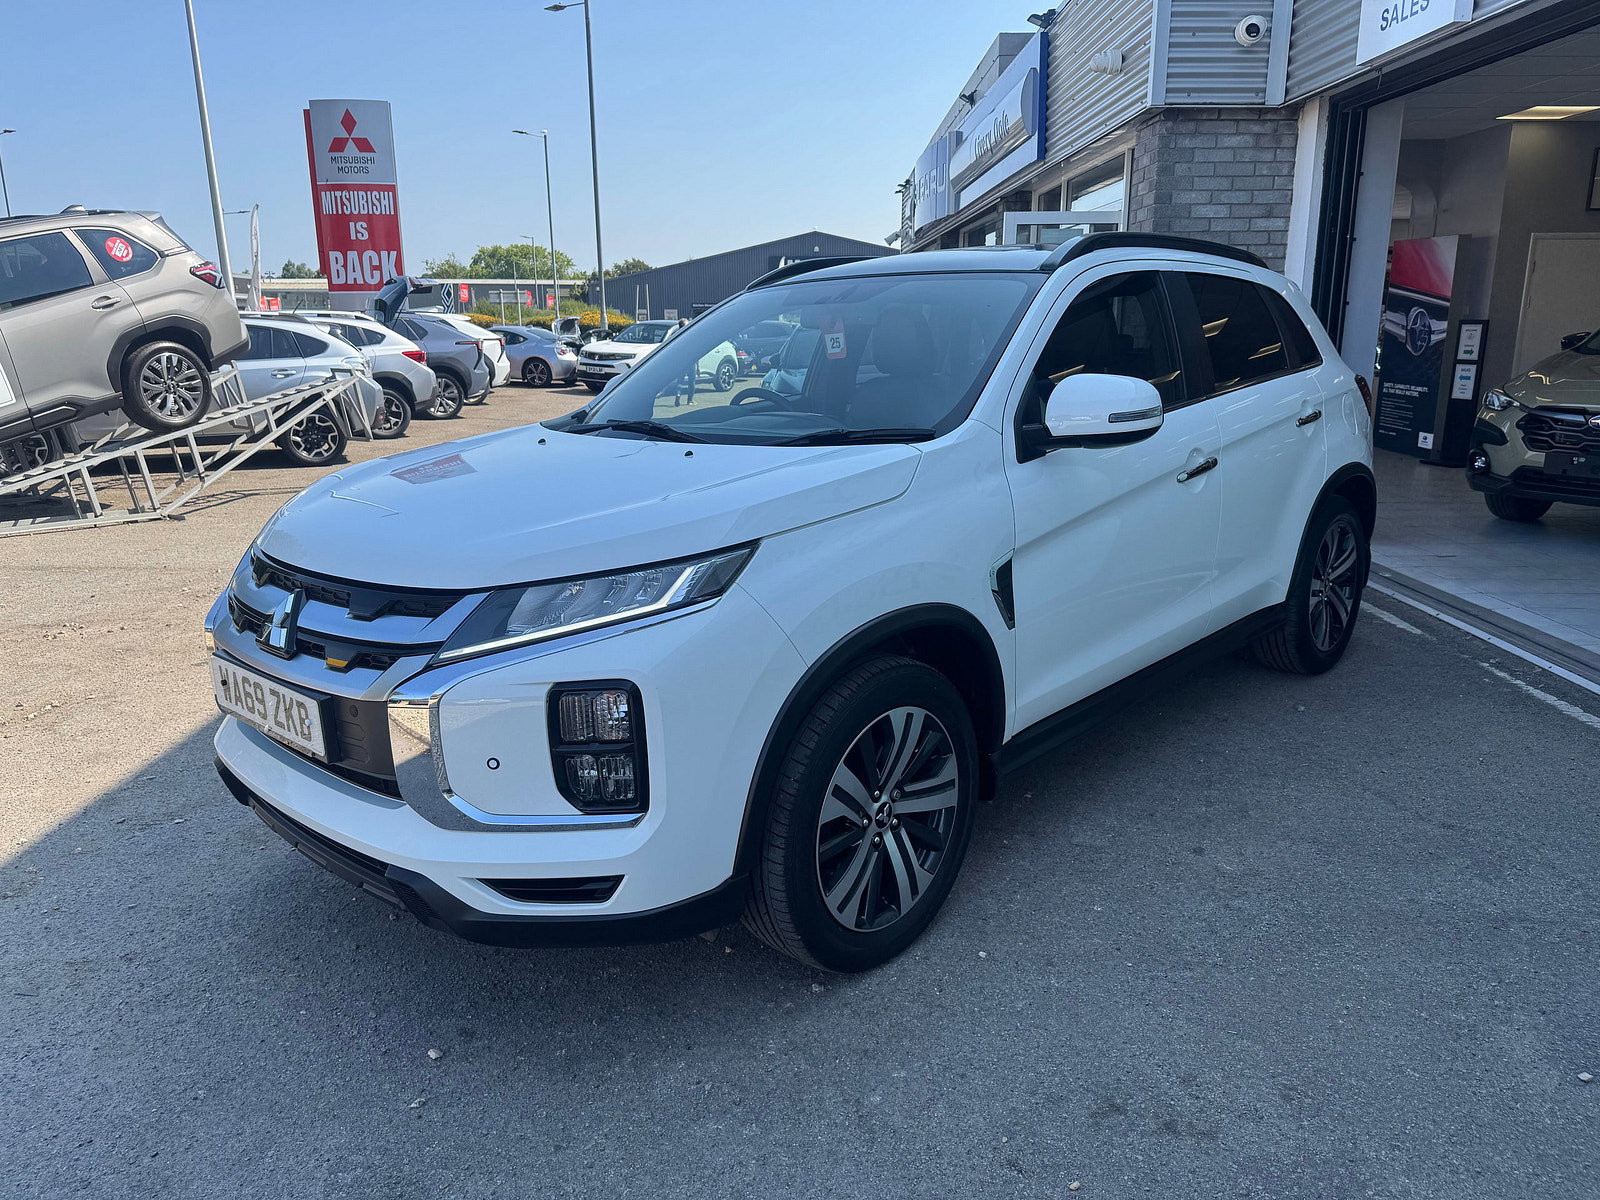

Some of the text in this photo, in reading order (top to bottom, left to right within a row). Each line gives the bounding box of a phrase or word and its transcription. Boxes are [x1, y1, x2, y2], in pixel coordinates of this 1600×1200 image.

[330, 156, 375, 164] MITSUBISHI
[337, 166, 370, 174] MOTORS
[321, 190, 395, 216] MITSUBISHI
[349, 221, 369, 241] IS
[328, 250, 399, 285] BACK
[830, 336, 842, 350] 25
[219, 664, 313, 742] WA69 ZKB
